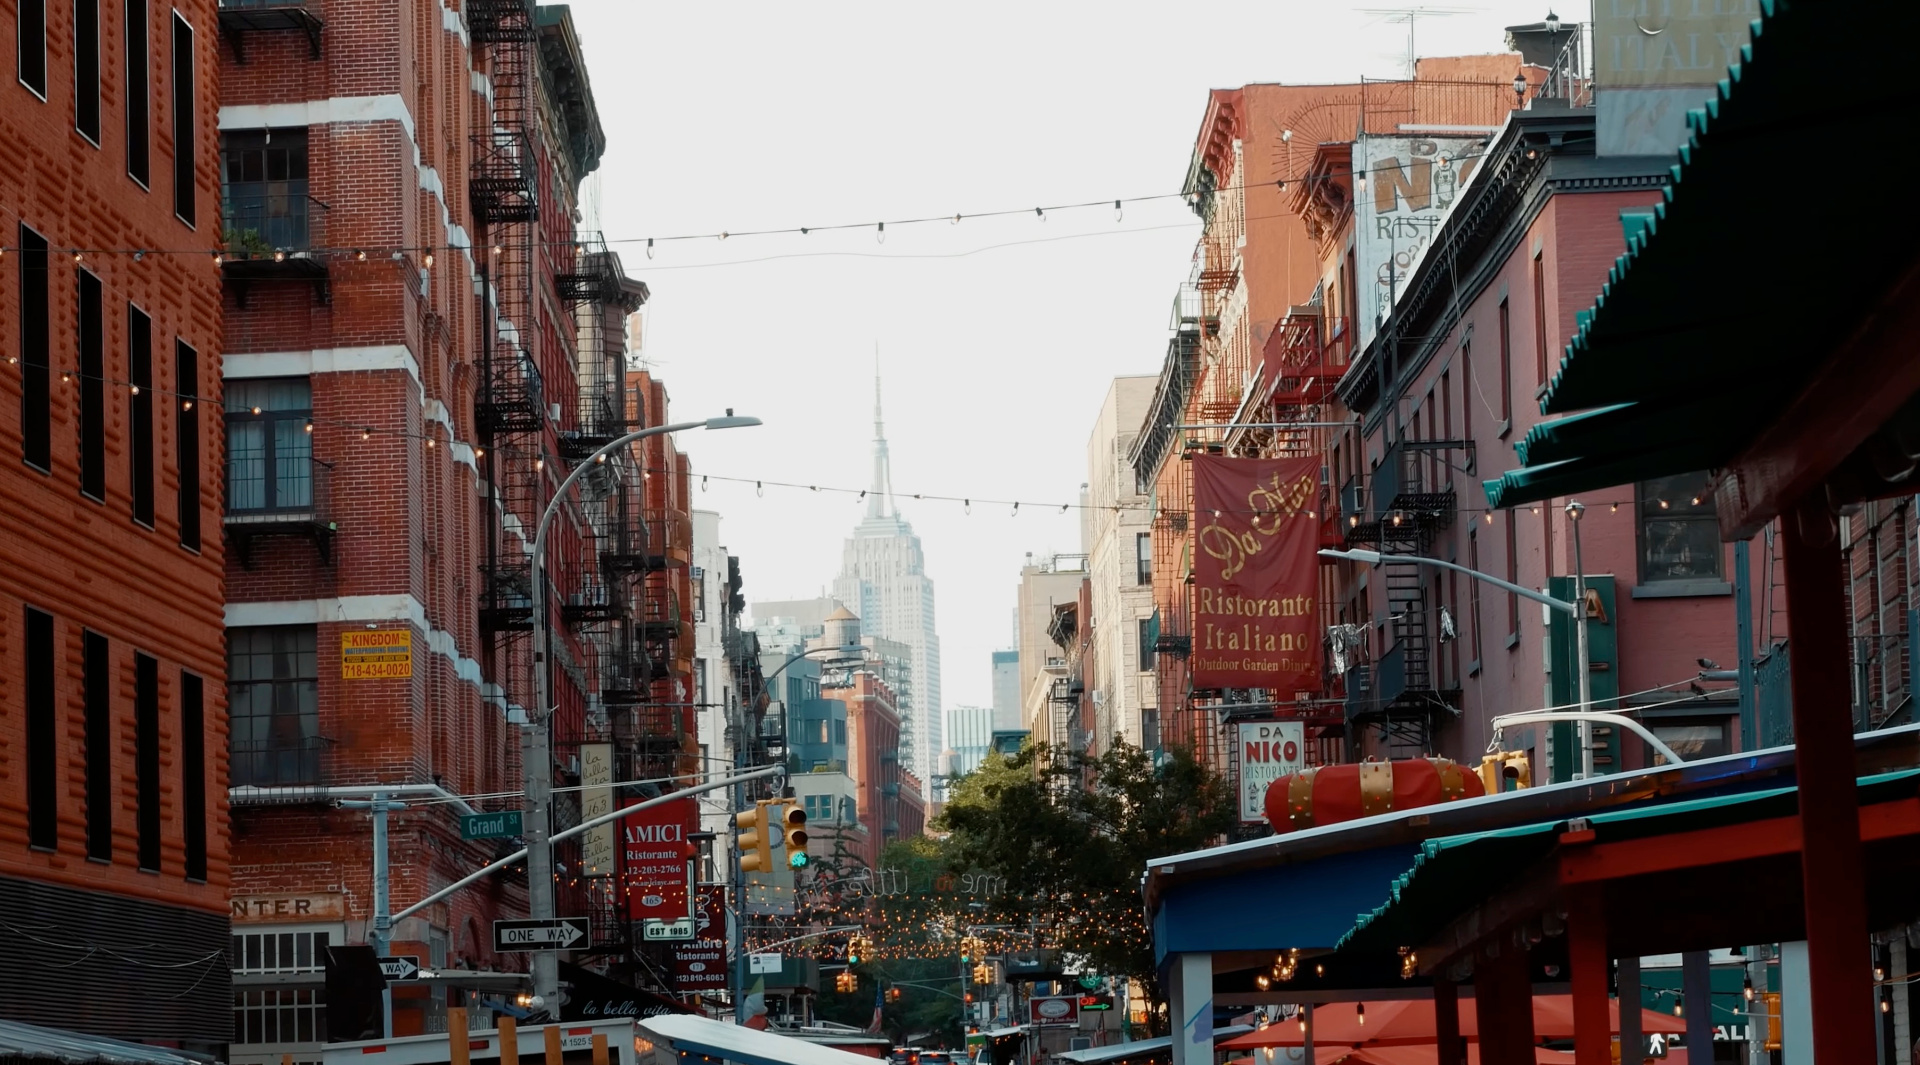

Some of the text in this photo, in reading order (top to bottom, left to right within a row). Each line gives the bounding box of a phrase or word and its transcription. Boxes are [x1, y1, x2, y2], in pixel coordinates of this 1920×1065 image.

[1609, 32, 1743, 72] ITALY
[1199, 471, 1316, 581] Da Nico
[1199, 587, 1314, 617] Ristorante
[351, 633, 400, 646] KINGDOM
[1204, 624, 1310, 652] Italiano
[344, 663, 410, 676] 718-434-0020
[1199, 657, 1240, 671] Outdoor
[1242, 657, 1280, 672] Garden
[1260, 726, 1284, 738] DA
[585, 750, 602, 765] la
[1245, 740, 1298, 764] NICO
[582, 762, 610, 780] bella
[468, 813, 518, 836] Grand St
[625, 823, 683, 844] AMICI
[626, 849, 678, 860] Ristorante
[626, 864, 681, 875] 12-203-2766
[232, 899, 312, 917] NTER
[645, 896, 660, 906] 165
[508, 928, 574, 942] ONE WAY
[650, 927, 689, 936] EST 1985
[676, 951, 720, 961] Ristorante
[386, 962, 410, 974] WAY
[690, 973, 725, 982] 810-6063
[582, 1000, 672, 1016] la bella vita
[428, 1015, 450, 1032] GELS
[569, 1037, 587, 1047] 1525
